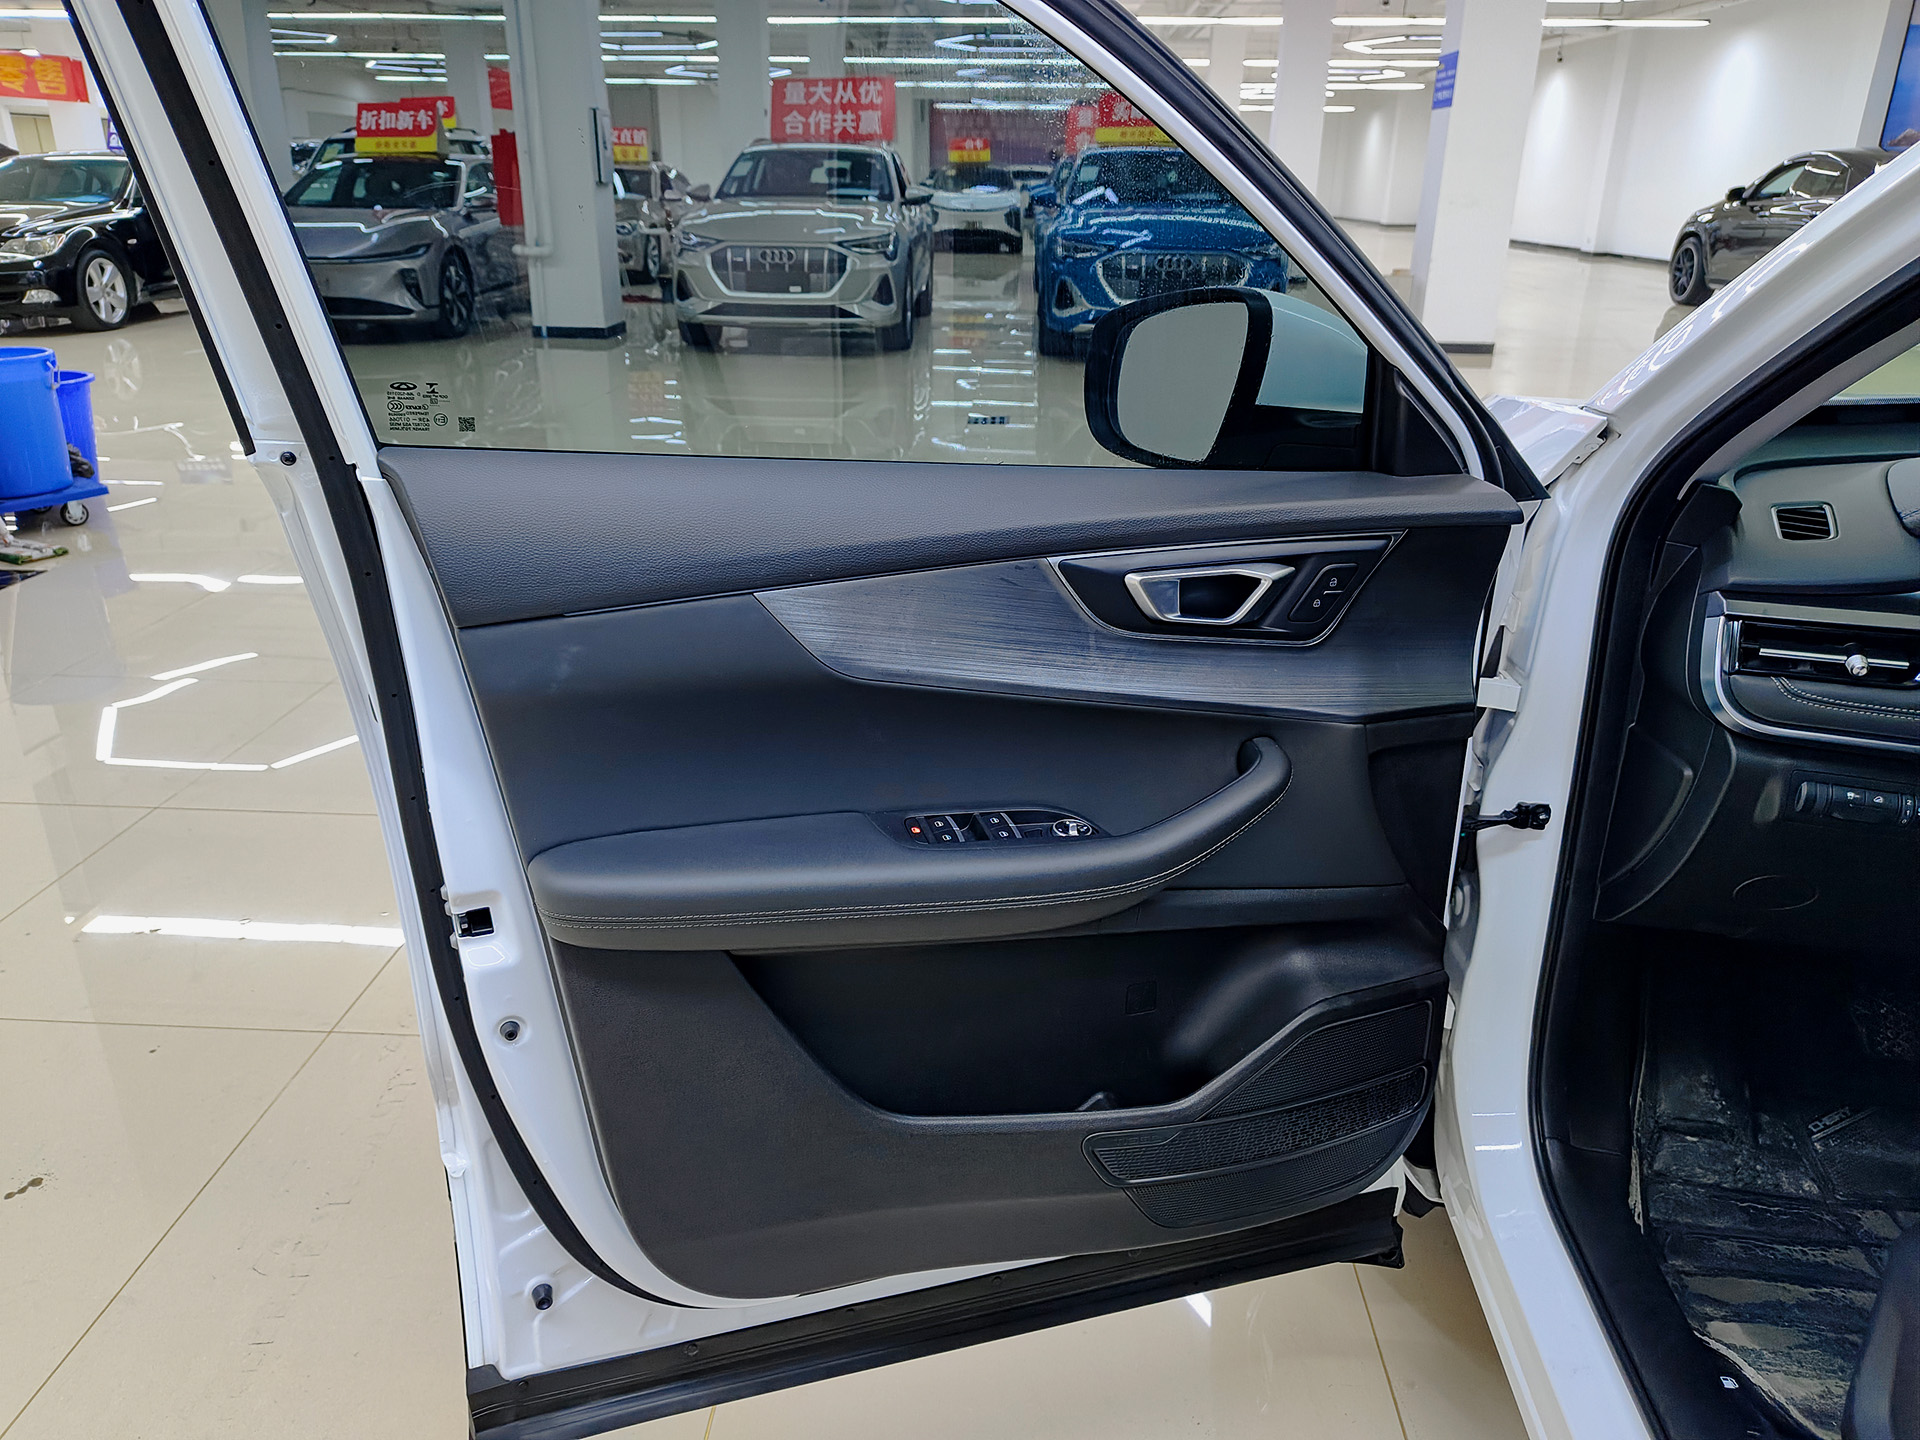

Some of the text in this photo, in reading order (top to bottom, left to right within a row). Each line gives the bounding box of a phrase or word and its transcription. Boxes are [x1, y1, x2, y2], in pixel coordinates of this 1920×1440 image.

[783, 80, 884, 105] 量大从优
[360, 109, 434, 130] 折扣新车
[782, 110, 883, 135] 合作共赢
